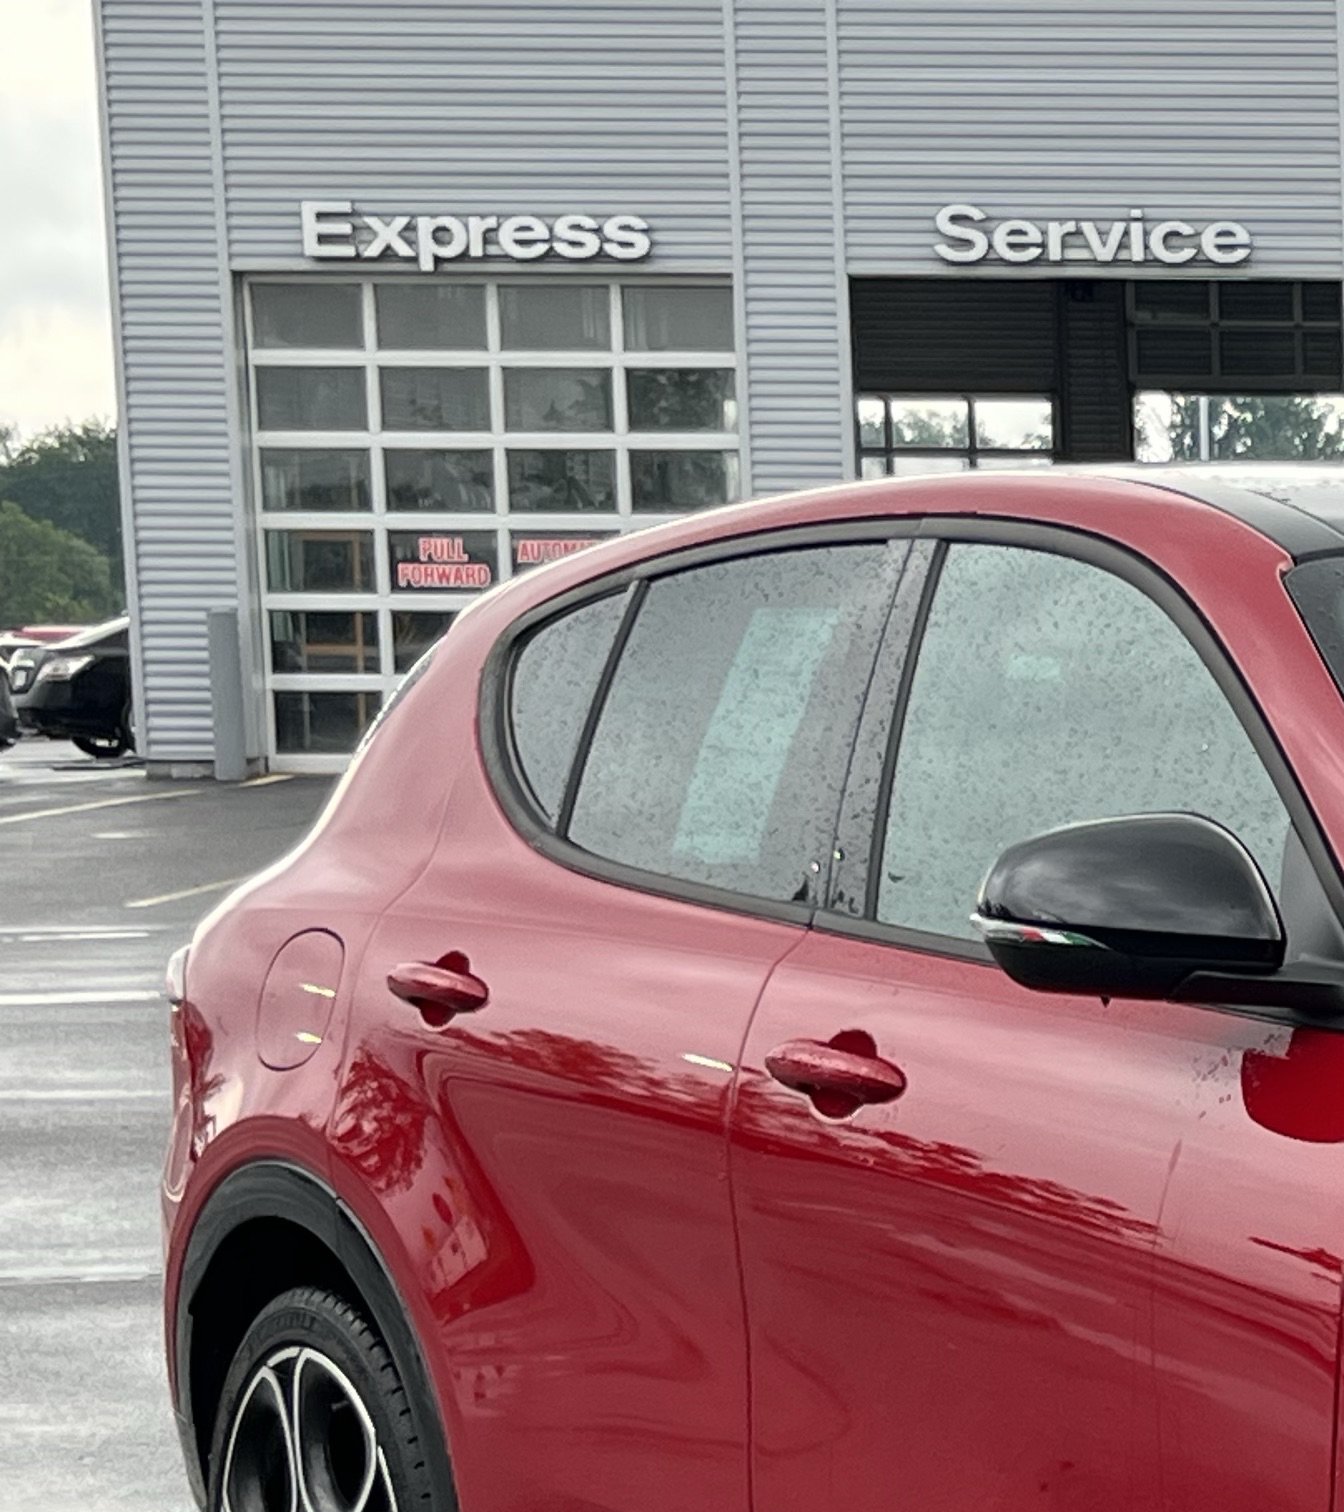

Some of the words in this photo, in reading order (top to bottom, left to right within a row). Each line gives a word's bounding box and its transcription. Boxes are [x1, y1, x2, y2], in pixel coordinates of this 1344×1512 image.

[301, 200, 652, 272] Express
[933, 204, 1252, 264] Service
[419, 538, 468, 561] PULL
[518, 541, 592, 562] AUTOM
[398, 563, 491, 587] FORWARD
